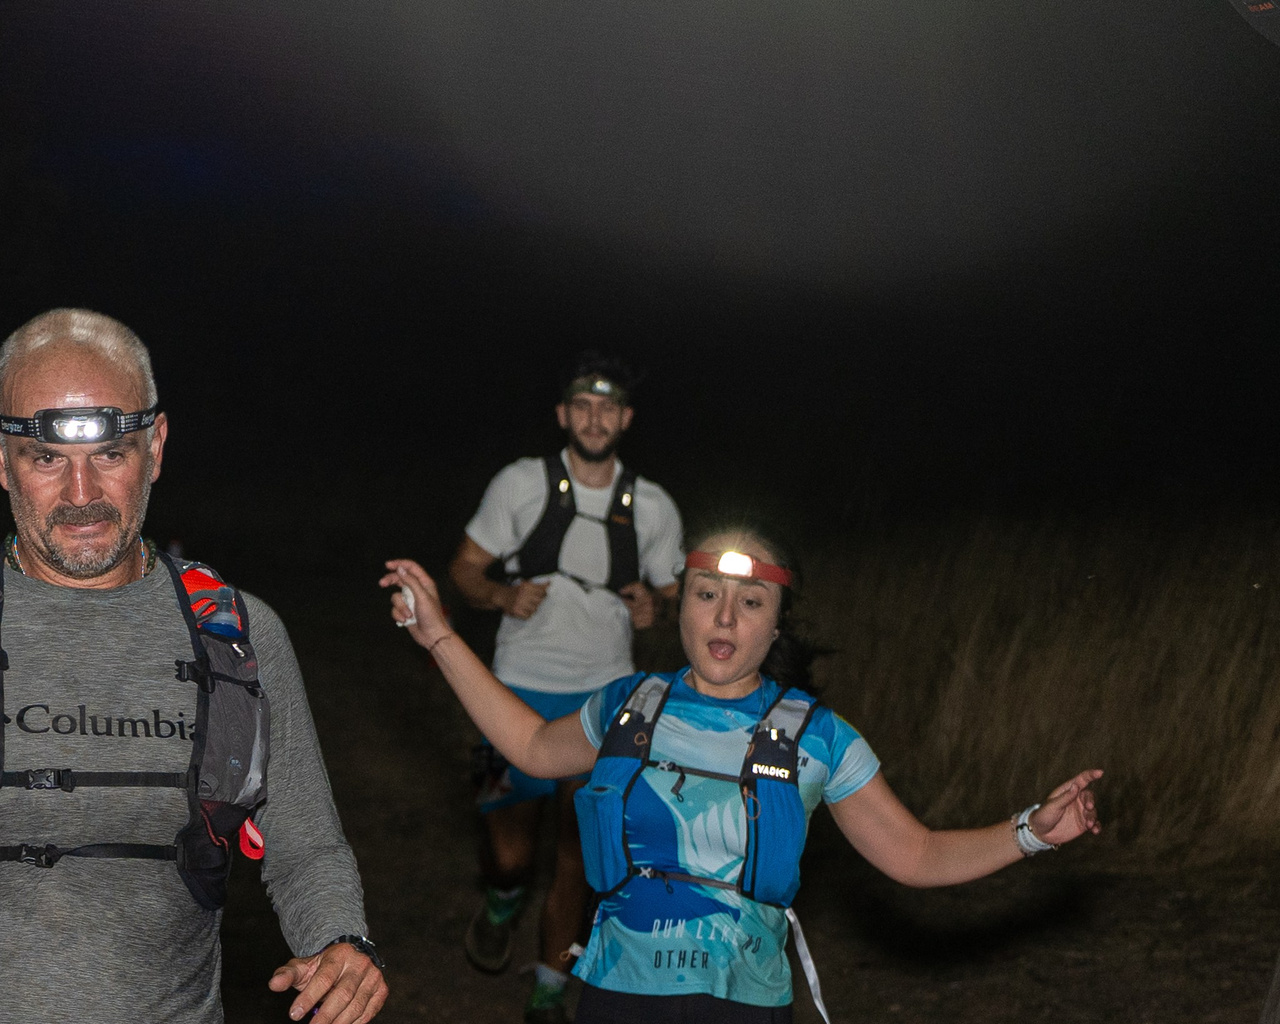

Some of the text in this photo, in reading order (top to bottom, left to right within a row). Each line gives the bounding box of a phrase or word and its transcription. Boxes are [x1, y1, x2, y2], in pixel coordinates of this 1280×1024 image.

[752, 763, 791, 779] EVADICT
[651, 918, 687, 939] RUN
[653, 950, 710, 969] OTHER
